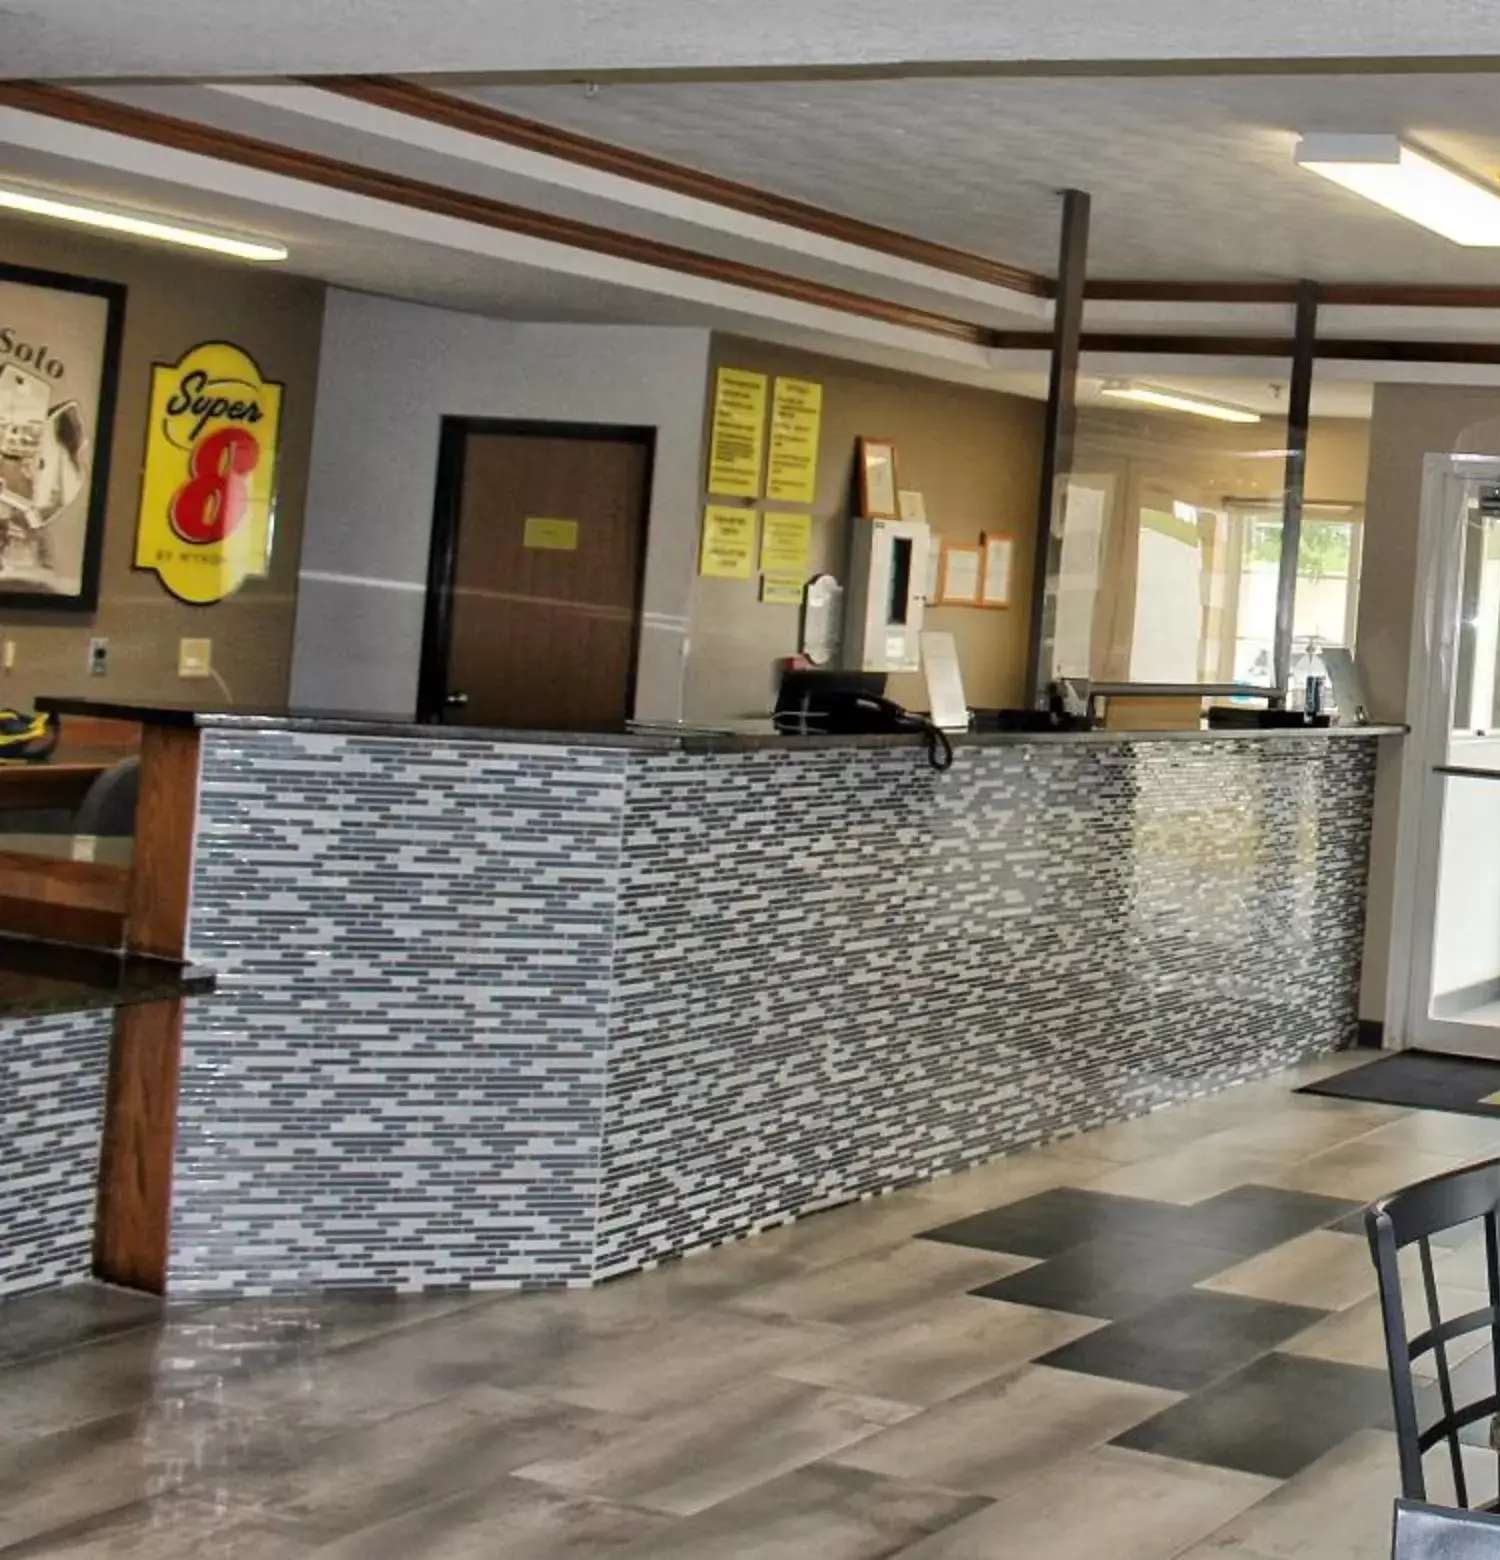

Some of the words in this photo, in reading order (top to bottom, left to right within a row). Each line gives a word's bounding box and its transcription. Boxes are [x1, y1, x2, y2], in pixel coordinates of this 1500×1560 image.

[0, 326, 65, 379] Solo
[166, 370, 264, 442] Super
[168, 427, 260, 545] 8
